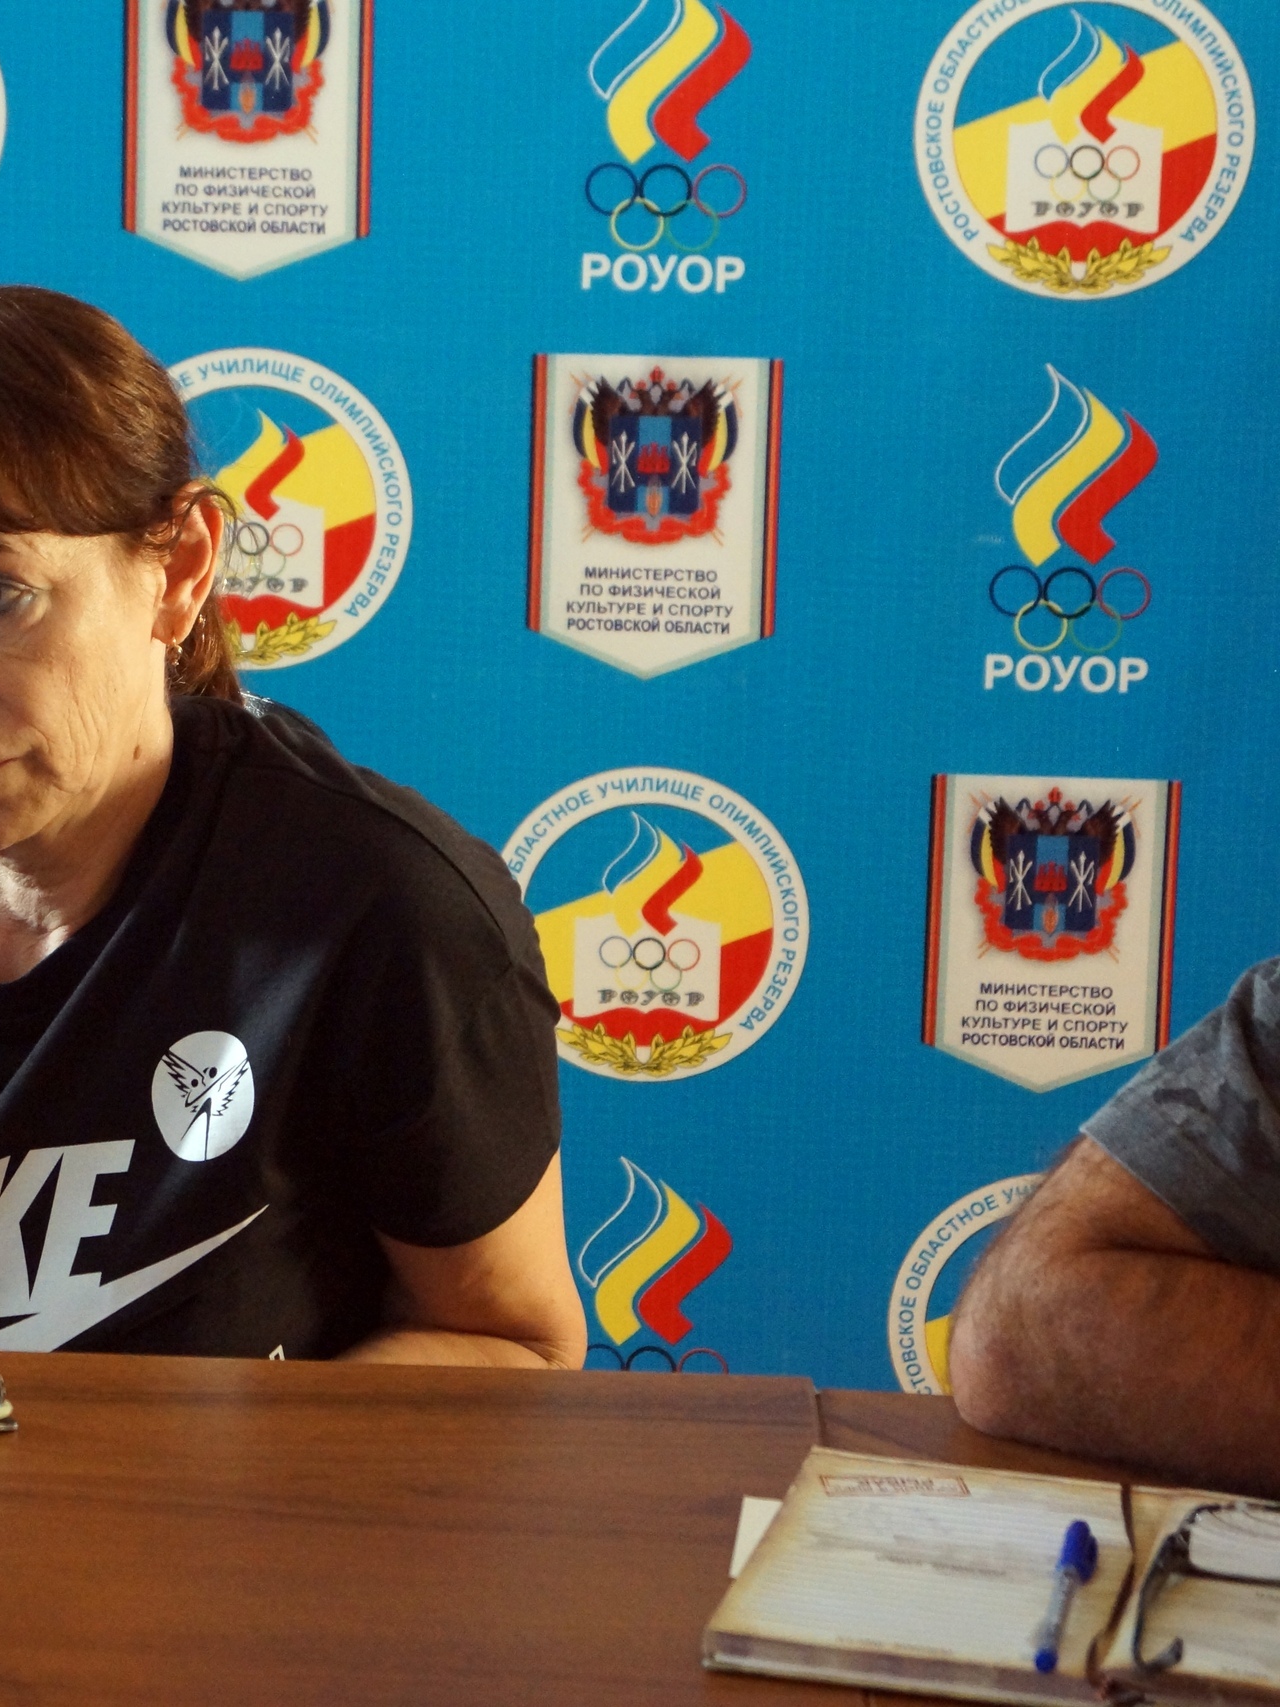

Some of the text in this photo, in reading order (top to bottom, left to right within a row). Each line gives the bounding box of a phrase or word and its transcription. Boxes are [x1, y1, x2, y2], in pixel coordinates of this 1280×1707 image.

[934, 0, 1031, 95] ОБЛАСТНО
[179, 165, 313, 181] МИНИСТЕРСТВО
[925, 100, 979, 241] РОСТОВСКОЕ
[175, 183, 316, 199] ПО ФИЗИЧЕСКОЙ
[1180, 153, 1242, 244] РЕЗЕРВА
[161, 201, 328, 217] КУЛЬТУРЕ И СПОРТУ
[162, 218, 325, 235] РОСТОВСКОЙ ОБЛАСТИ
[581, 252, 746, 294] РОУОР
[198, 357, 403, 618] УЧИЛИЩЕ ОЛИМПИЙСКОГО РЕЗЕРВА
[584, 566, 718, 583] МИНИСТЕРСТВО
[580, 583, 721, 600] ПО ФИЗИЧЕСКОЙ
[566, 600, 733, 618] КУЛЬТУРЕ И СПОРТУ
[567, 617, 730, 635] РОСТОВСКОЙ ОБЛАСТИ
[984, 653, 1149, 694] РОУОР
[509, 777, 800, 1032] БЛАСТНОЕ УЧИЛИЩЕ ОЛИМПИЙСКОГО РЕЗЕРВА
[980, 982, 1113, 999] МИНИСТЕРСТВО
[976, 1000, 1116, 1016] ПО ФИЗИЧЕСКОЙ
[961, 1016, 1128, 1034] КУЛЬТУРЕ И СПОРТУ
[962, 1033, 1125, 1050] РОСТОВСКОЙ ОБЛАСТИ
[906, 1194, 1000, 1290] ОБЛАСТНОЕ
